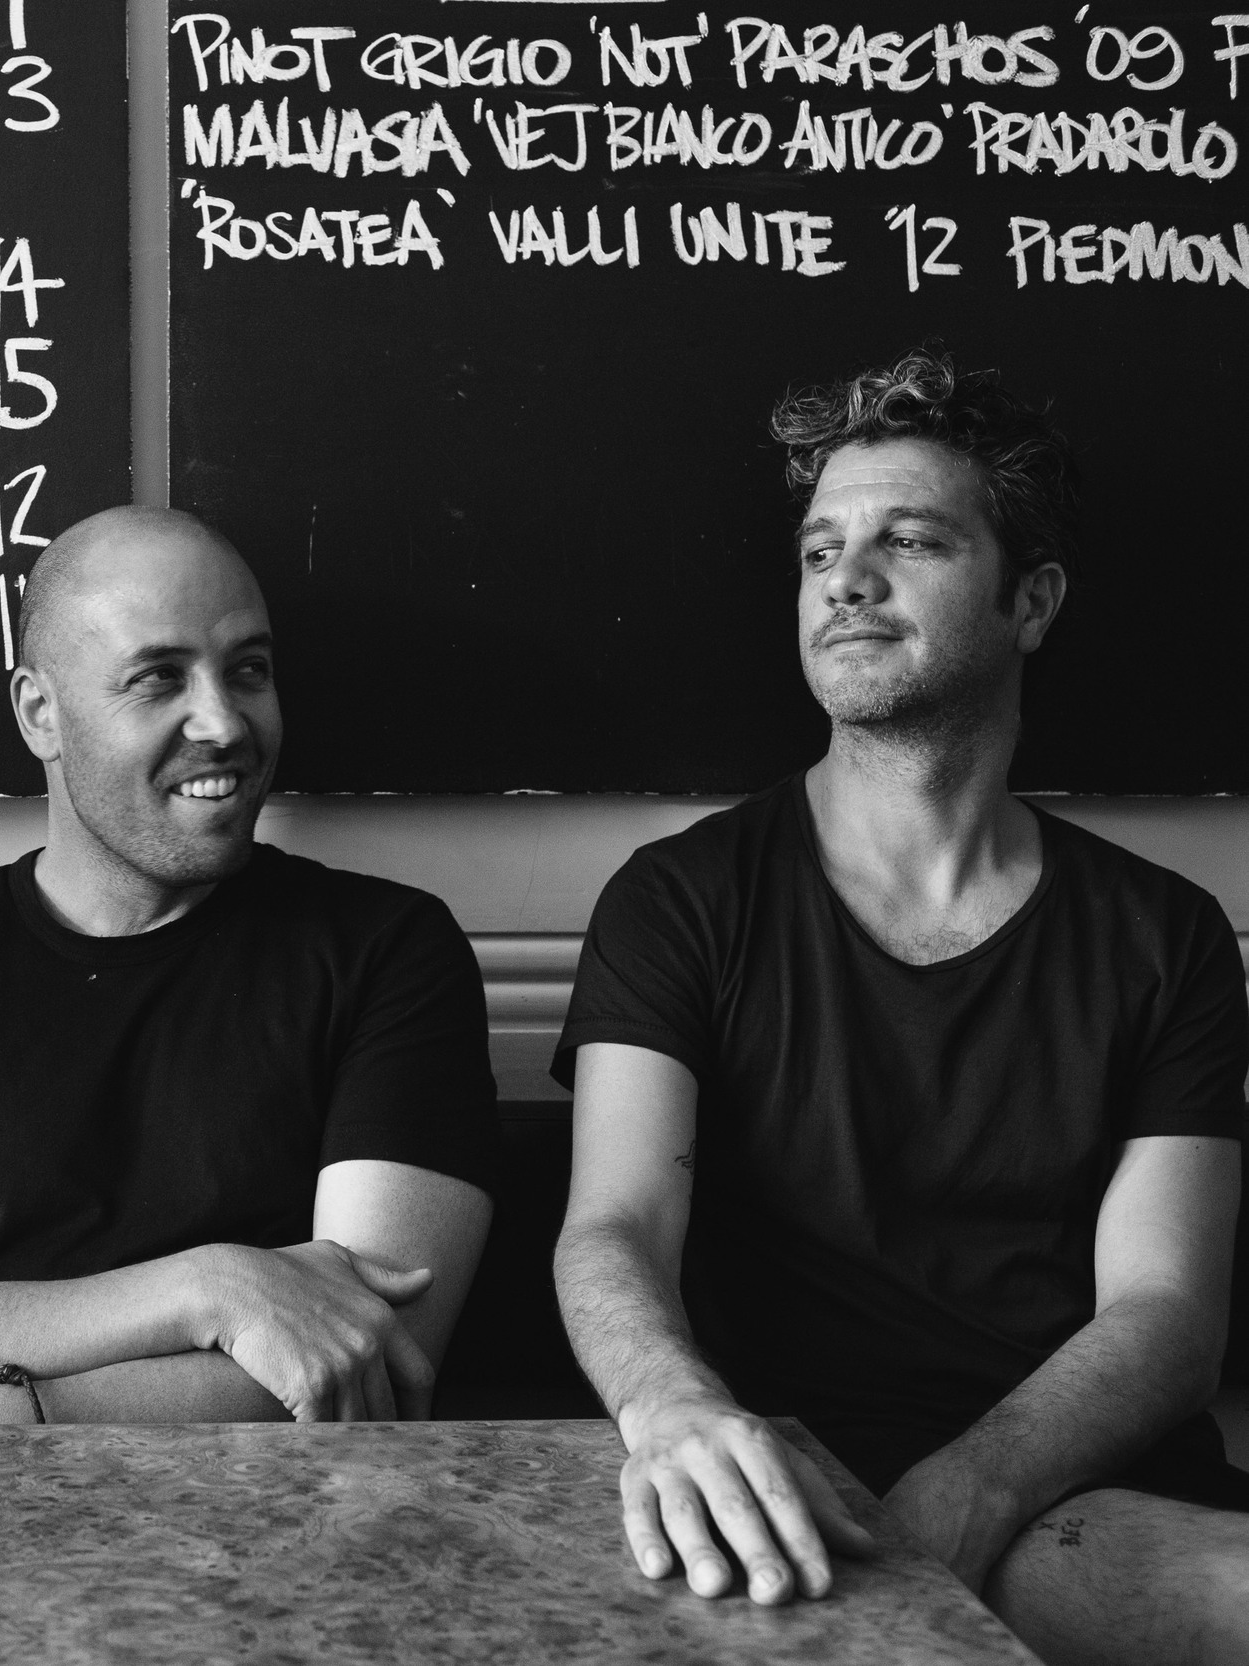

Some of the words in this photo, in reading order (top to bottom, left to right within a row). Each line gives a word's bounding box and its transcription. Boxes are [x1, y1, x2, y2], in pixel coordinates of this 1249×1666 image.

[171, 14, 356, 92] PINOT
[361, 33, 571, 89] GRIGIO
[590, 13, 708, 87] 'NOT'
[726, 18, 1058, 91] PARASCHOS
[1075, 5, 1183, 90] '09
[184, 97, 471, 178] MALVASIA
[604, 102, 771, 171] BIANCO
[963, 102, 1236, 178] PRADAROLO
[489, 206, 639, 268] VALLI
[671, 202, 846, 276] UNITE
[885, 204, 959, 292] '12
